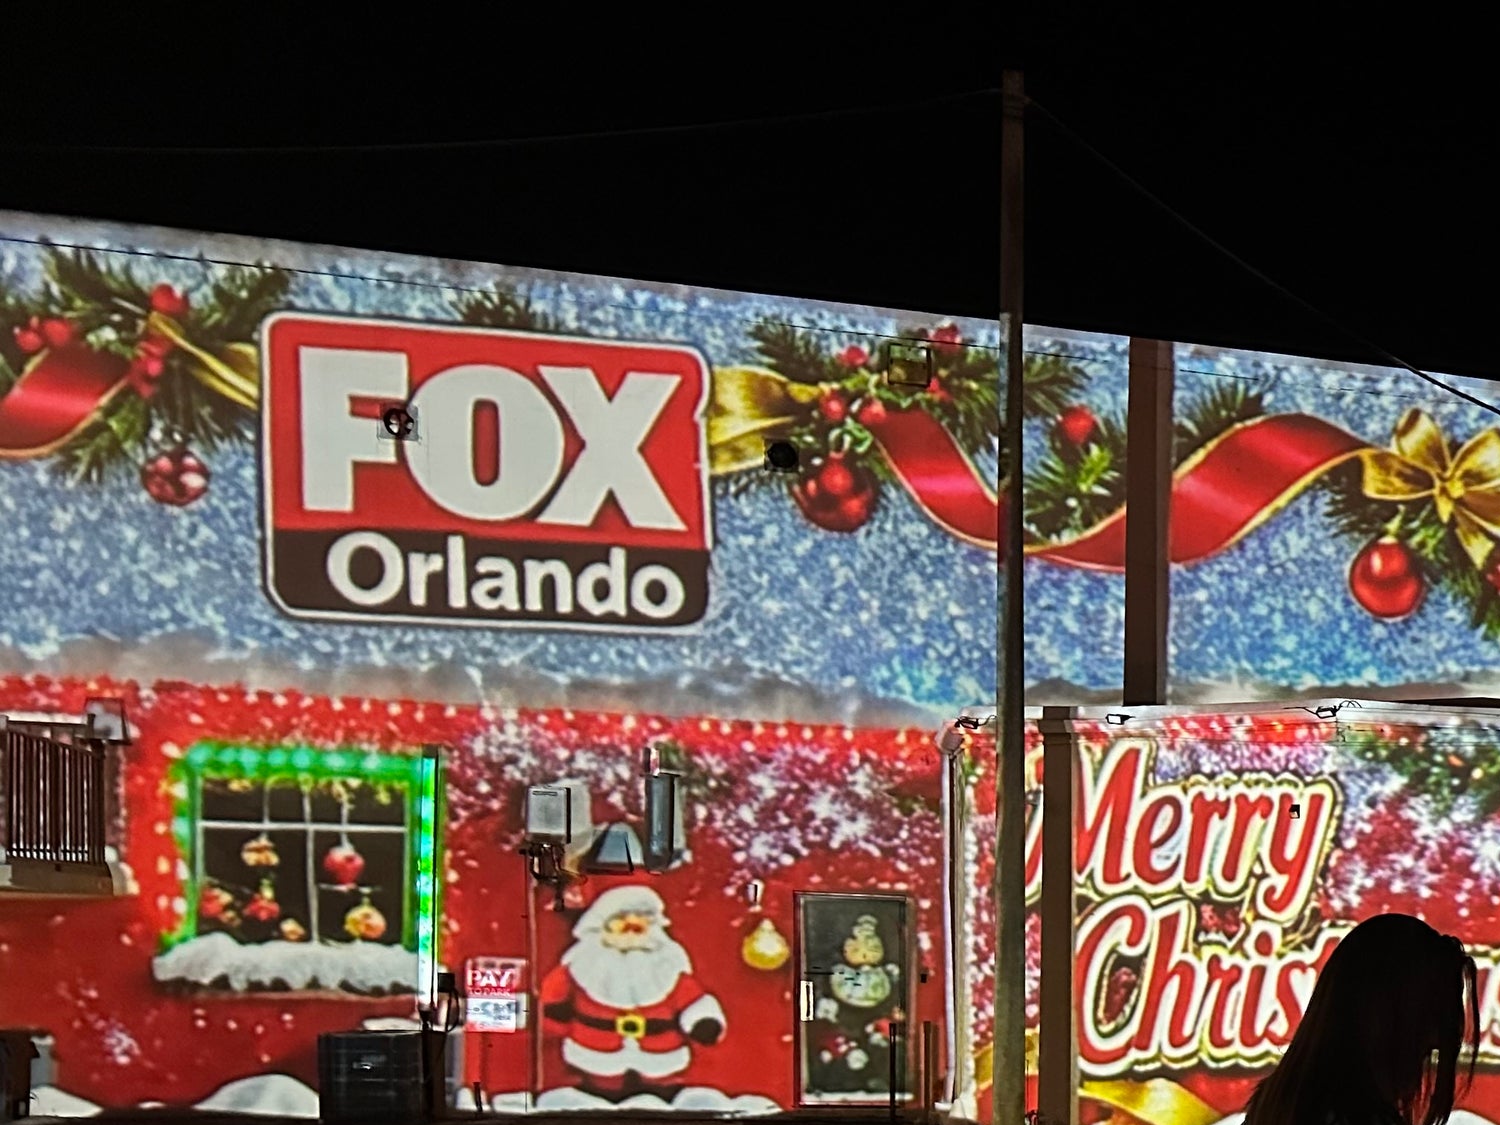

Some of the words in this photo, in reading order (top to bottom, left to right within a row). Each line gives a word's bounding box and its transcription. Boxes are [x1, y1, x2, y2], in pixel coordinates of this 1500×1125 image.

[299, 344, 689, 532] FOX
[326, 530, 686, 619] Orlando
[1024, 742, 1332, 918] Merry
[467, 969, 514, 987] PAY
